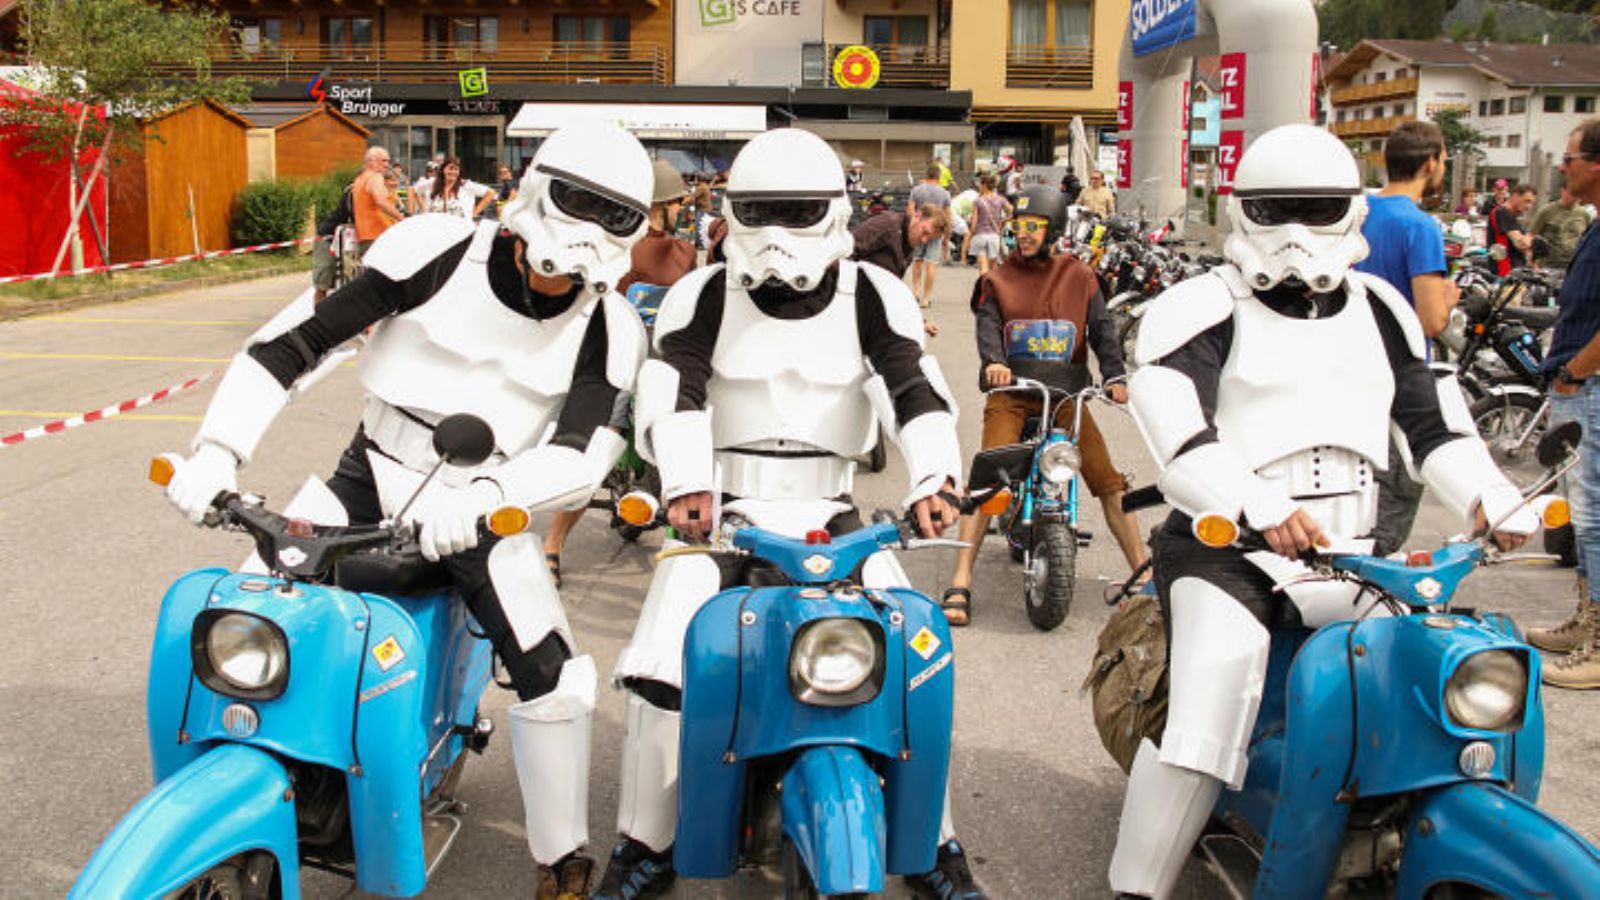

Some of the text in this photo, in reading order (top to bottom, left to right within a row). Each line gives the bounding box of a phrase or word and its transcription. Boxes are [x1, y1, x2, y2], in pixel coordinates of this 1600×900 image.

[752, 0, 800, 16] CAFE
[330, 85, 371, 102] Sport
[341, 101, 406, 118] Brugger
